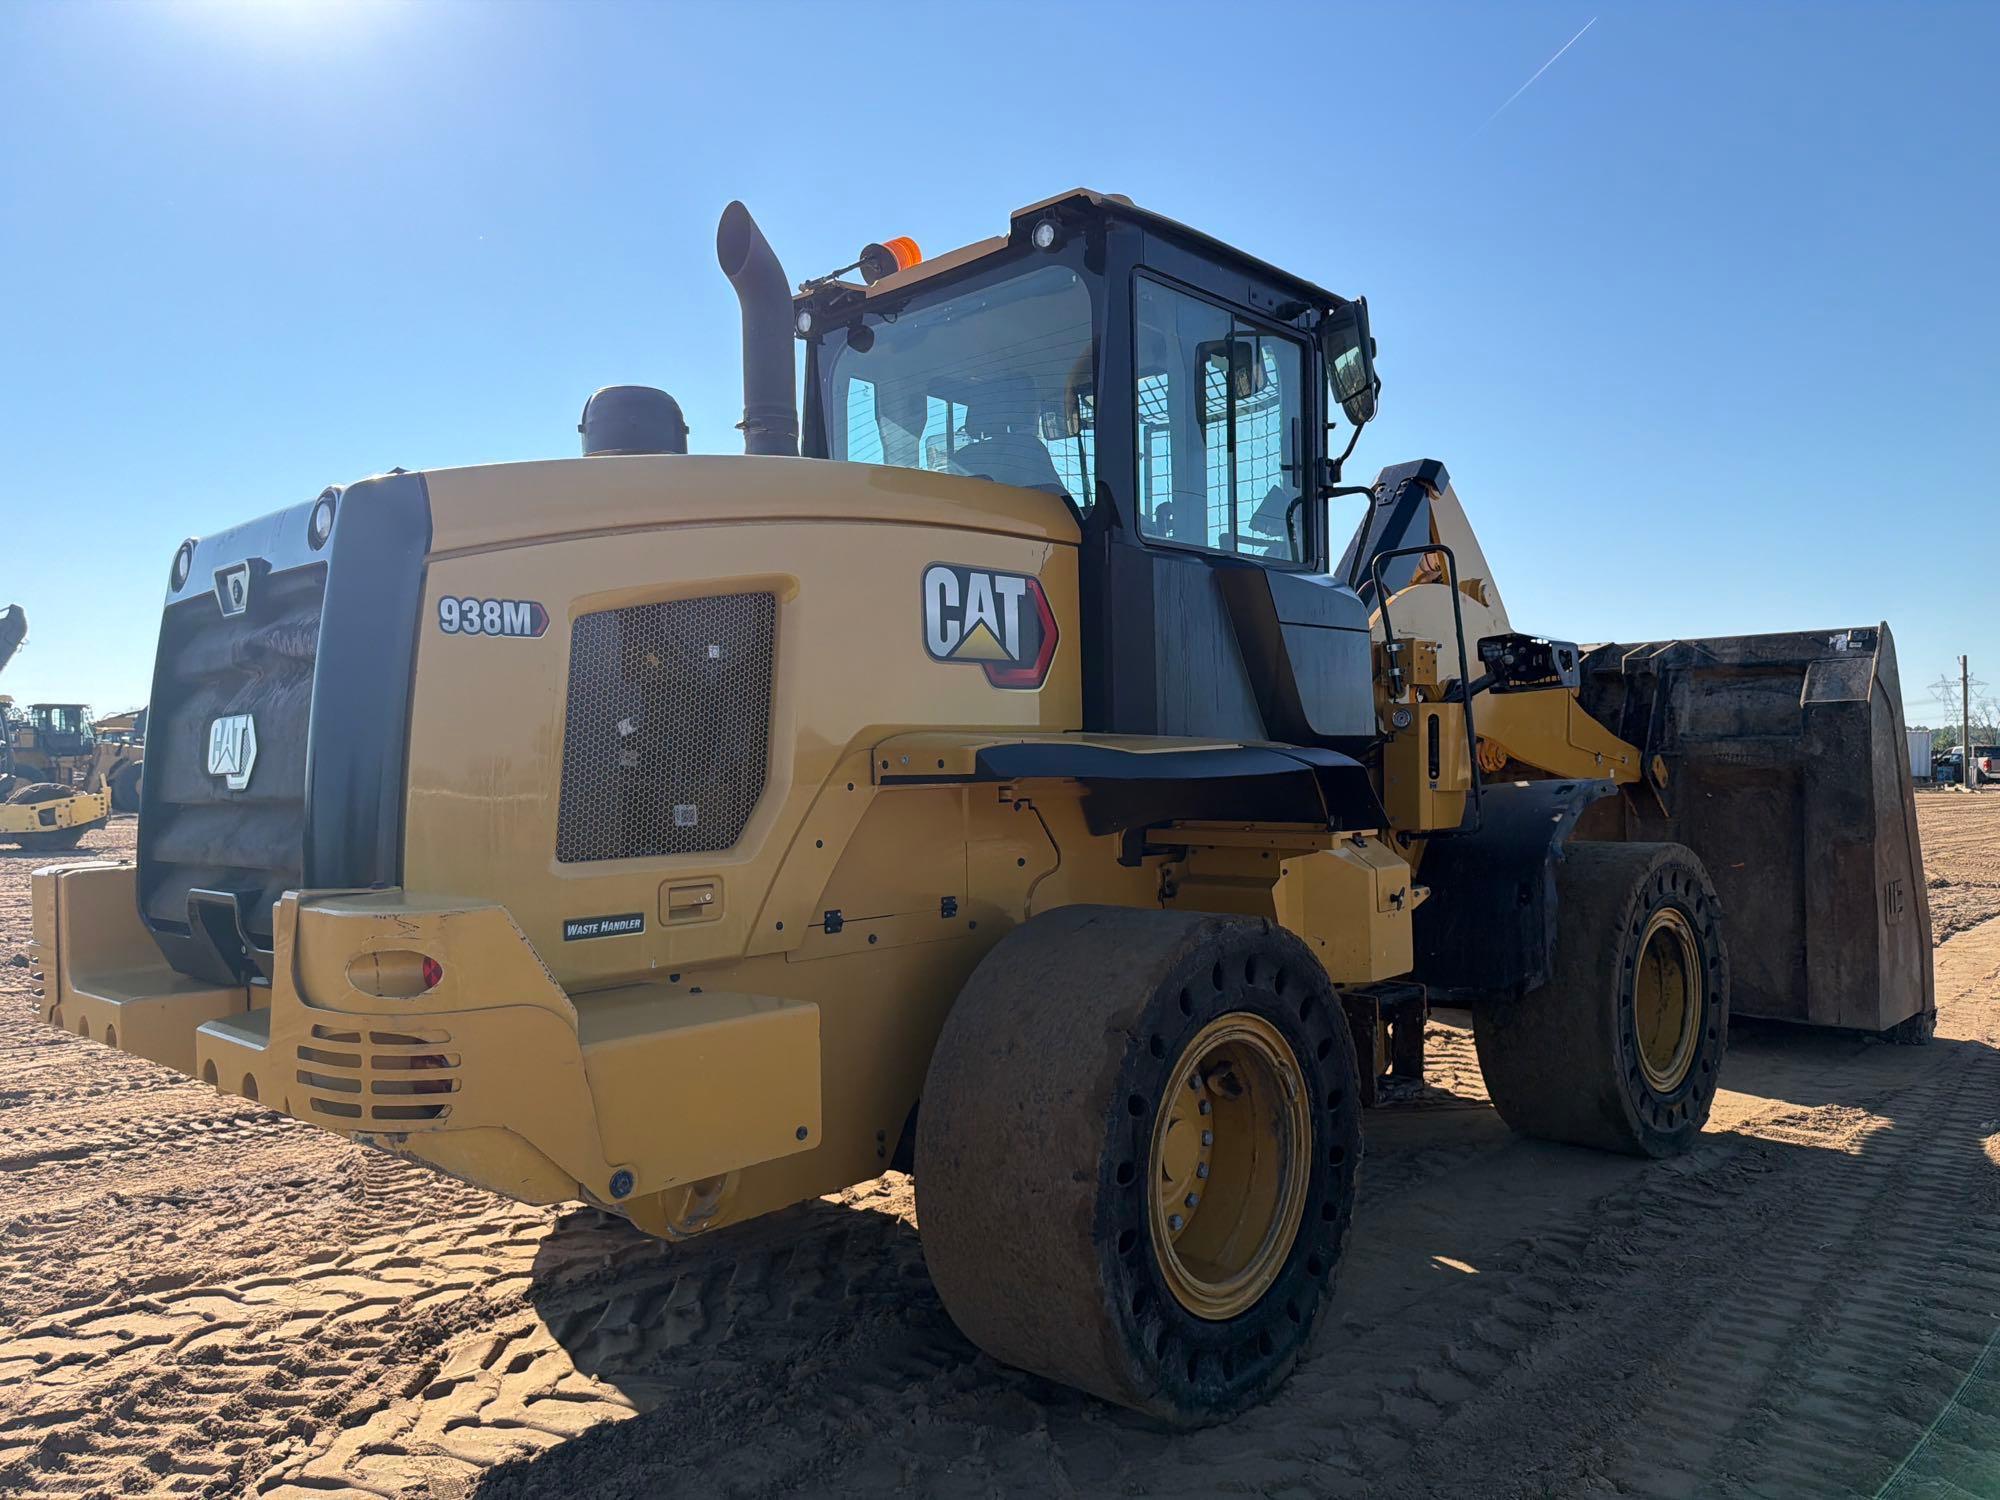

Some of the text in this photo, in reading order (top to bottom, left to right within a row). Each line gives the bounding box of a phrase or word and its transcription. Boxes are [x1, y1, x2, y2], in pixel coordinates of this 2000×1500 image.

[440, 598, 531, 635] 938M
[925, 566, 1026, 661] CAT
[208, 715, 247, 774] CAT
[567, 919, 641, 936] WASTE HANDLER
